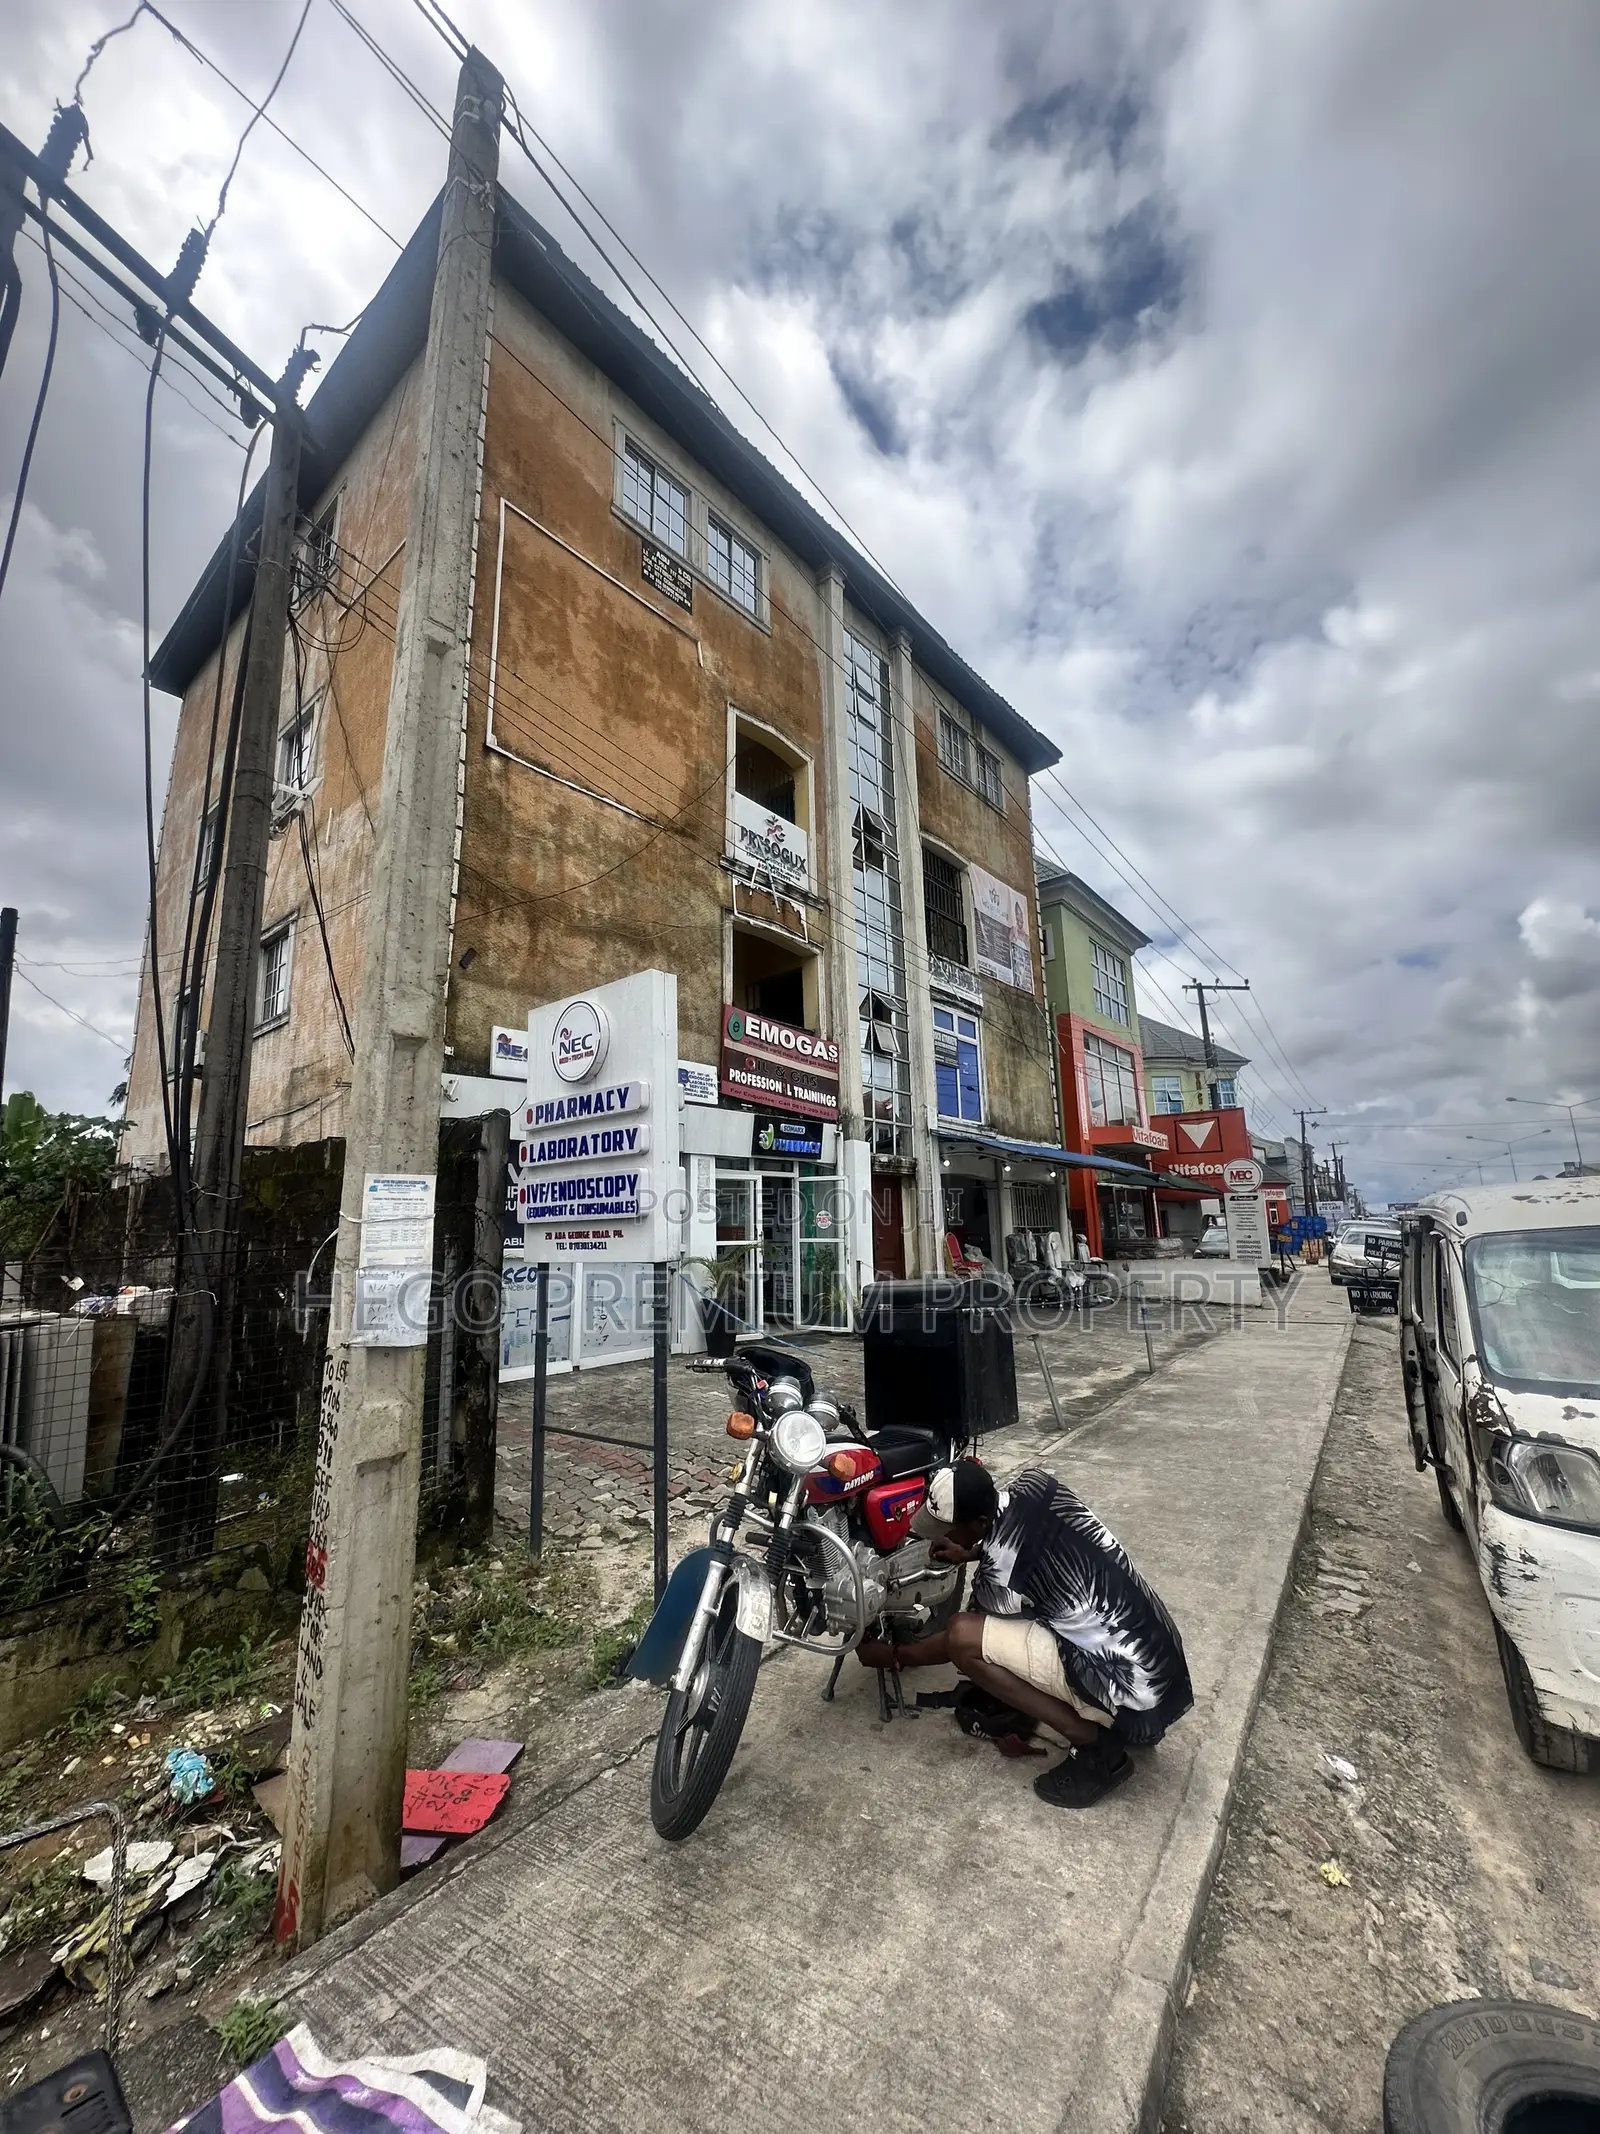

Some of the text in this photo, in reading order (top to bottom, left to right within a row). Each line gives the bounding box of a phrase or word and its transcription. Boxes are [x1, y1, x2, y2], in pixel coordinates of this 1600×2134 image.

[559, 1033, 593, 1057] NEC
[745, 1016, 838, 1061] EMOGAS
[535, 1087, 629, 1125] PHARMACY
[793, 1085, 837, 1108] TRAININGS
[529, 1128, 638, 1163] LABORATORY
[1168, 1162, 1225, 1177] Vitafoa
[1230, 1170, 1253, 1180] MBC
[527, 1174, 638, 1204] IVF/ENDOSCOPY
[569, 1205, 575, 1217] &
[576, 1200, 639, 1216] CONSUMABLES)
[568, 1231, 590, 1240] GEORGE
[1368, 1236, 1403, 1248] NO PARKING
[1367, 1249, 1384, 1257] POLICE
[1351, 1289, 1361, 1299] NO
[843, 1470, 875, 1492] DAYLONG
